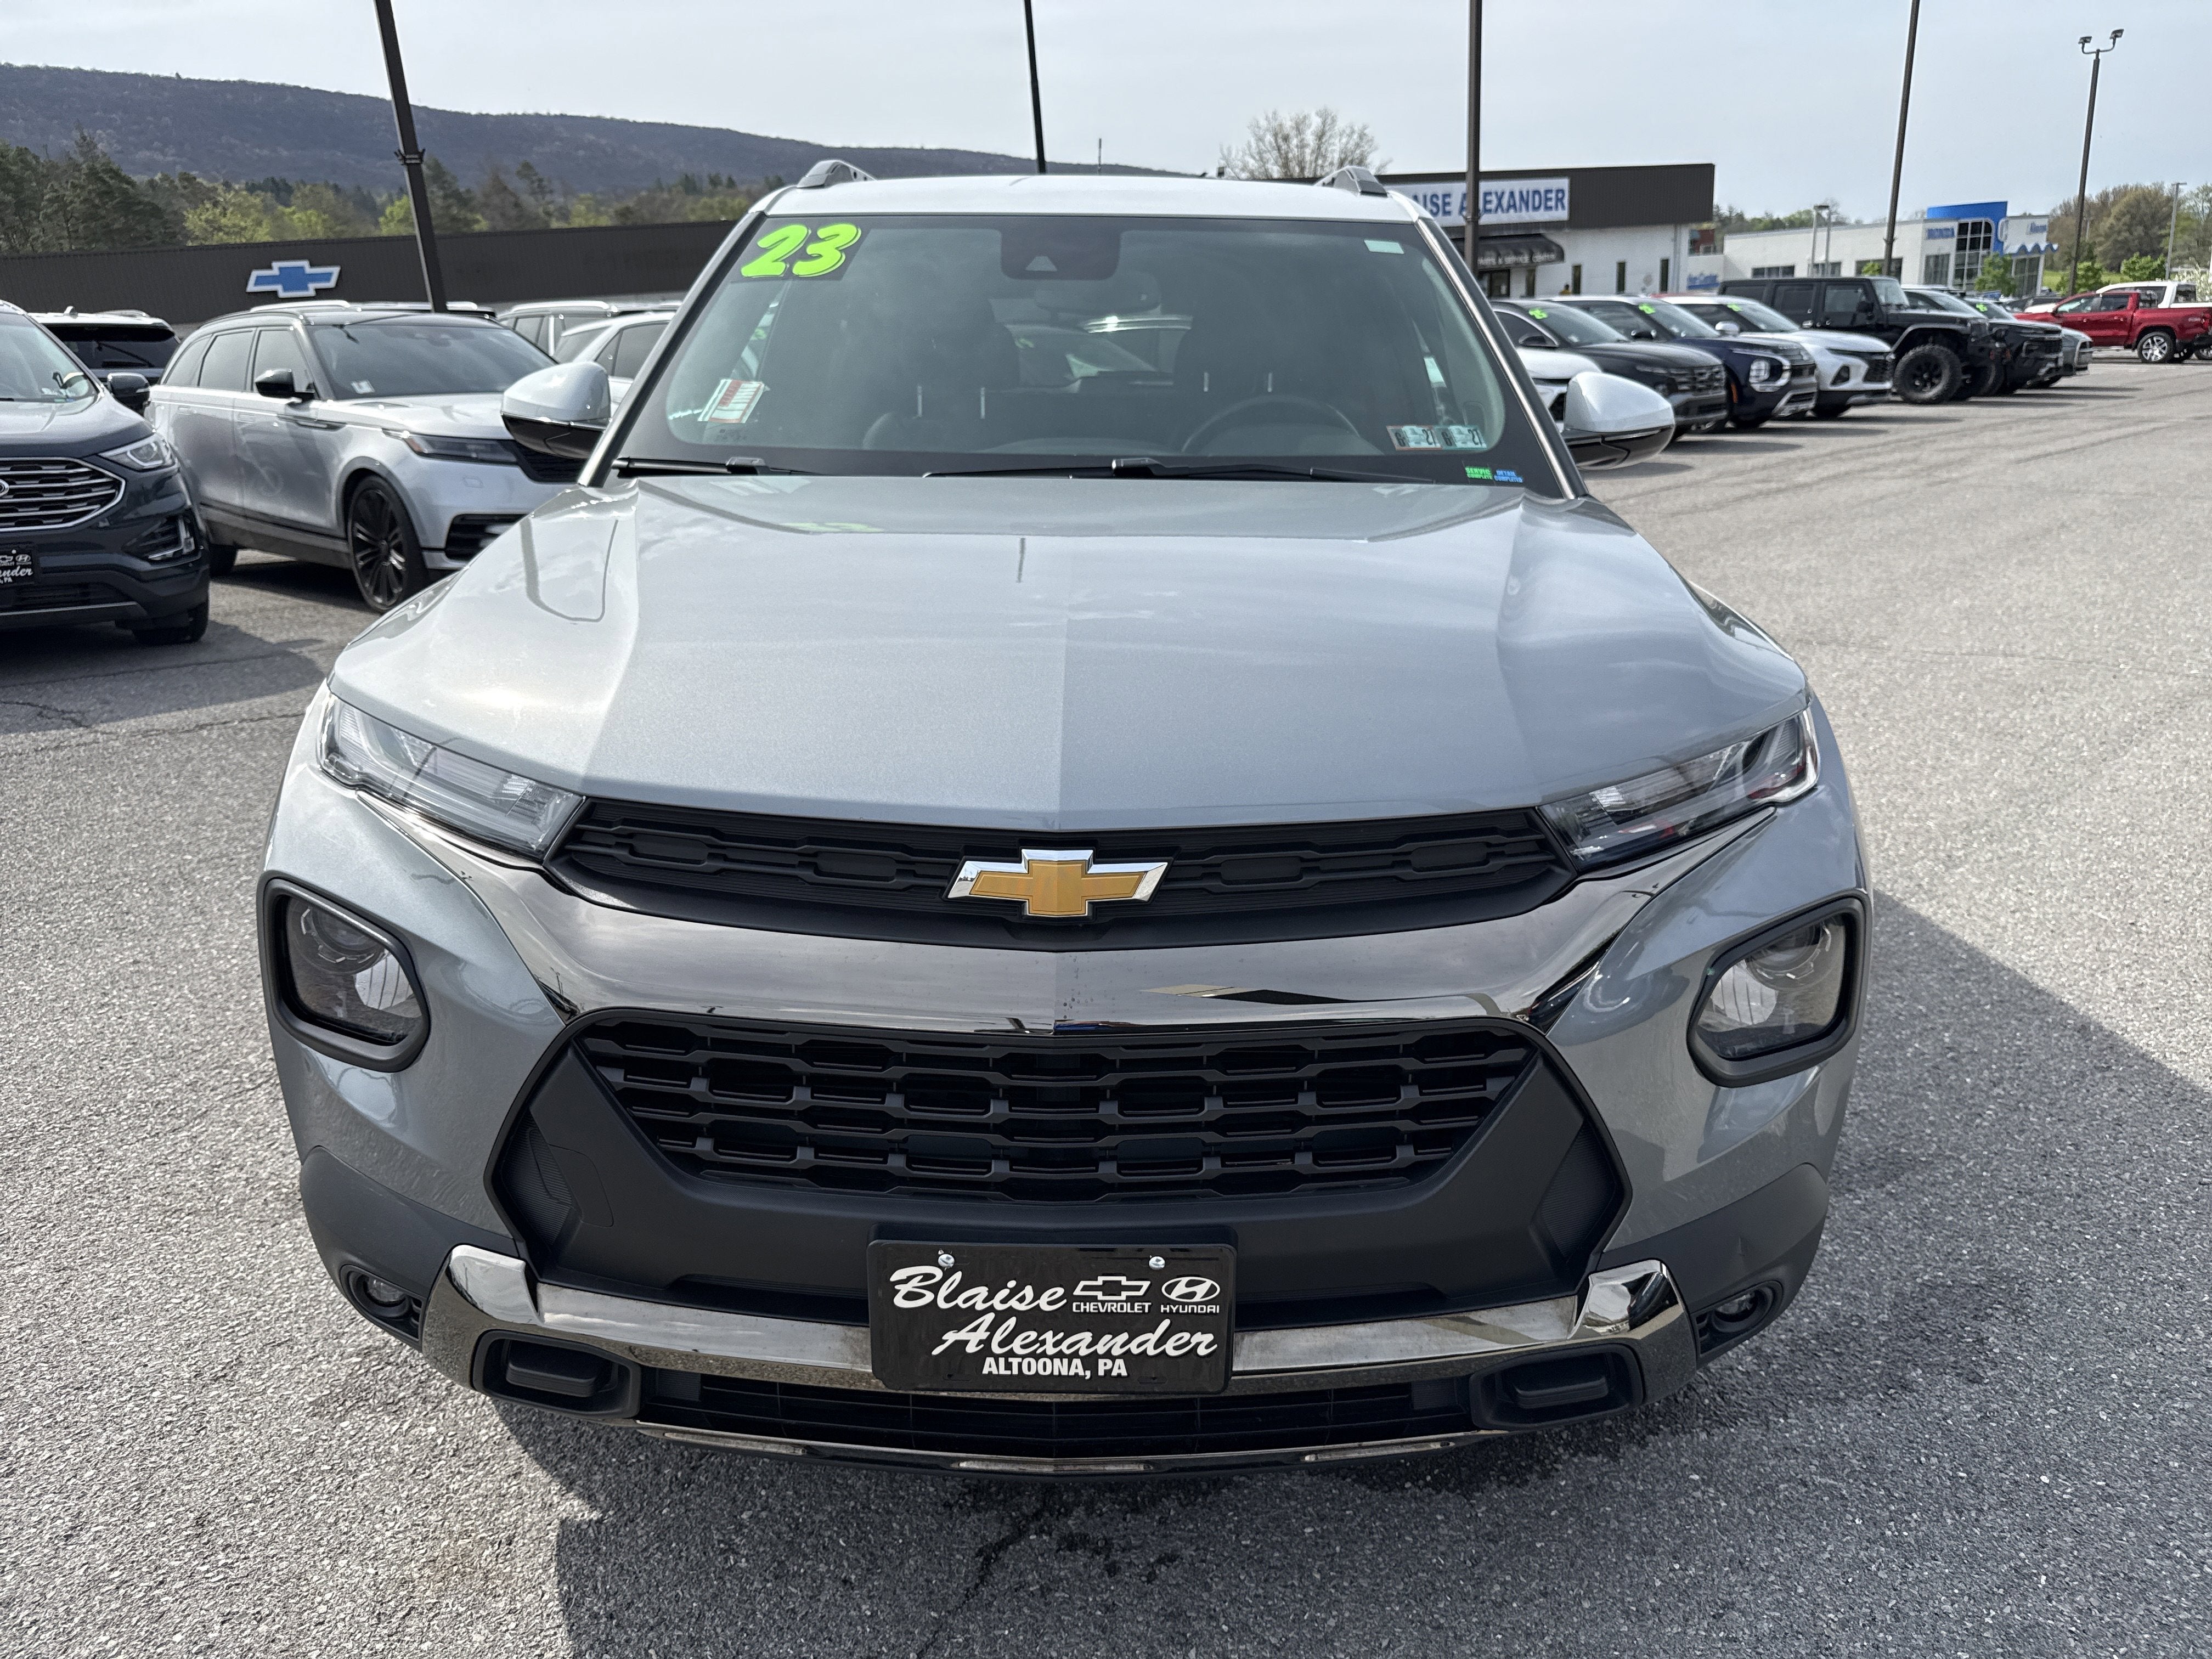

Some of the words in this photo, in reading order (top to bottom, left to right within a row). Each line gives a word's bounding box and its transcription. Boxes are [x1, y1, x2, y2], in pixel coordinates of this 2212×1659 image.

[1459, 189, 1566, 216] AEXANDER
[741, 224, 861, 277] 23
[889, 1266, 1068, 1311] Blaise
[1073, 1302, 1152, 1313] CHEVROLET
[1160, 1305, 1220, 1314] HYUNDAI
[932, 1312, 1218, 1356] Alexander
[982, 1357, 1092, 1380] ALTOONA,
[1098, 1359, 1128, 1377] PA
